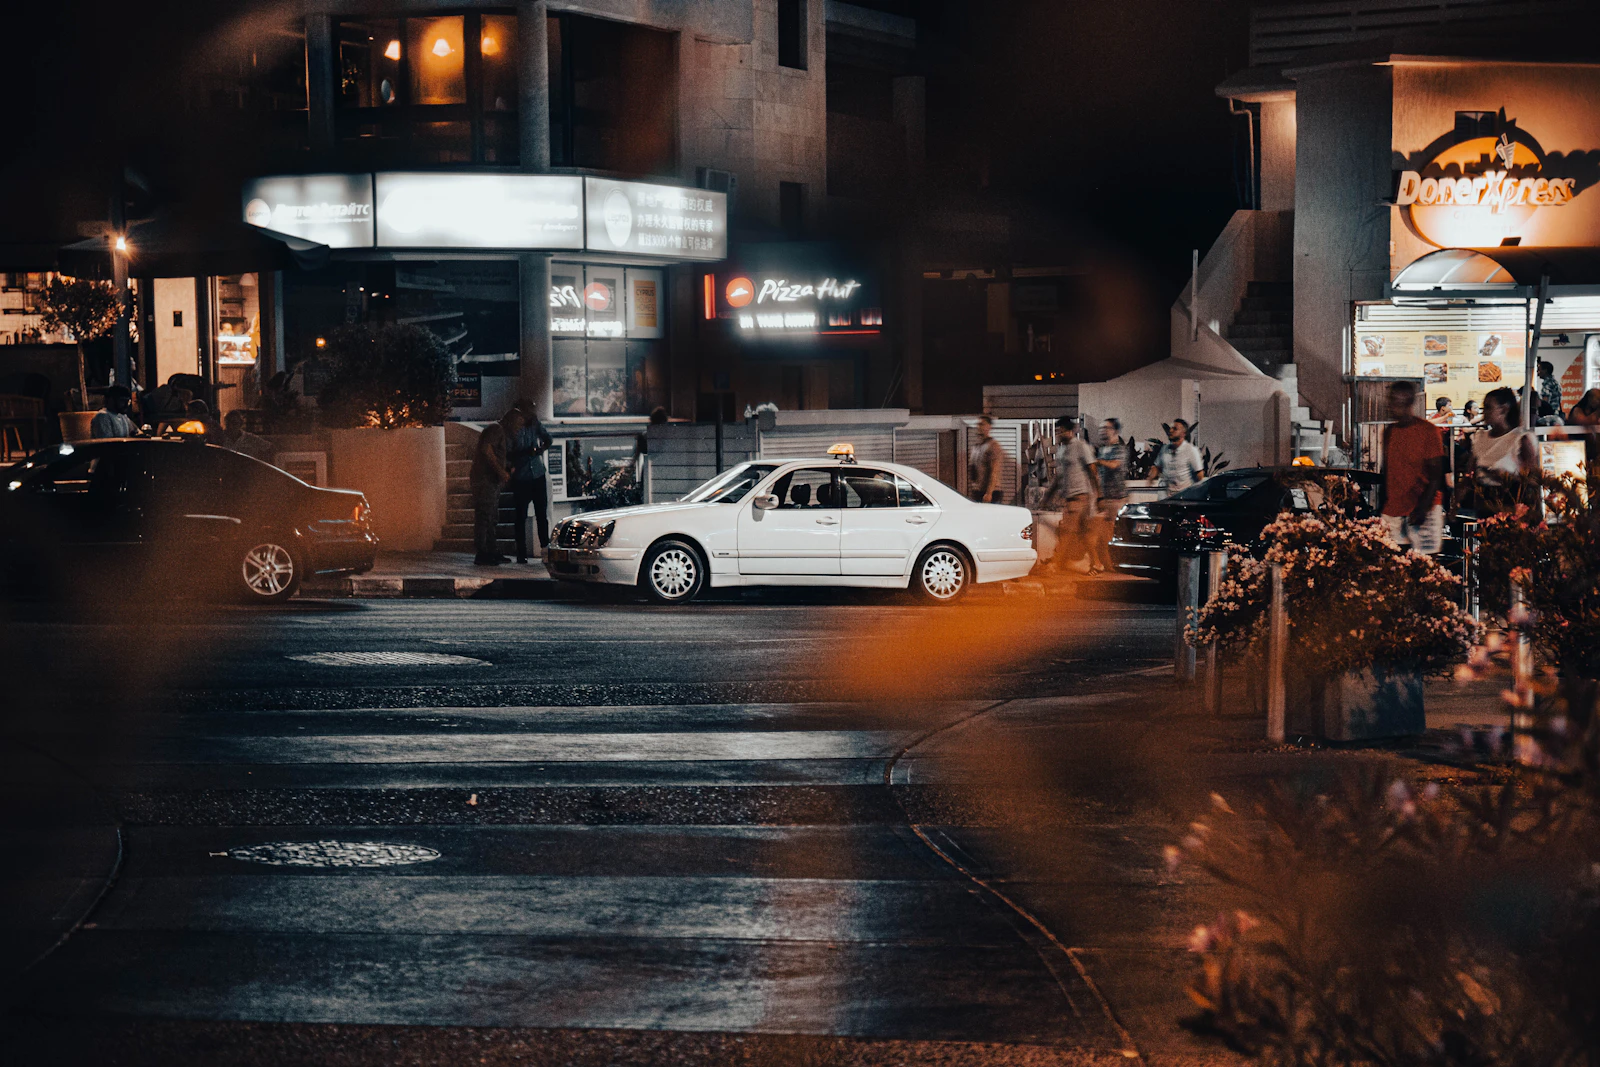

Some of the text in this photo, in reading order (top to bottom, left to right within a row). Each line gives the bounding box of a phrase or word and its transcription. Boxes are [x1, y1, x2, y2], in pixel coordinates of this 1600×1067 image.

[636, 288, 655, 297] CYPRUS
[756, 277, 862, 304] Pizza Hut
[450, 388, 480, 397] YPRUS
